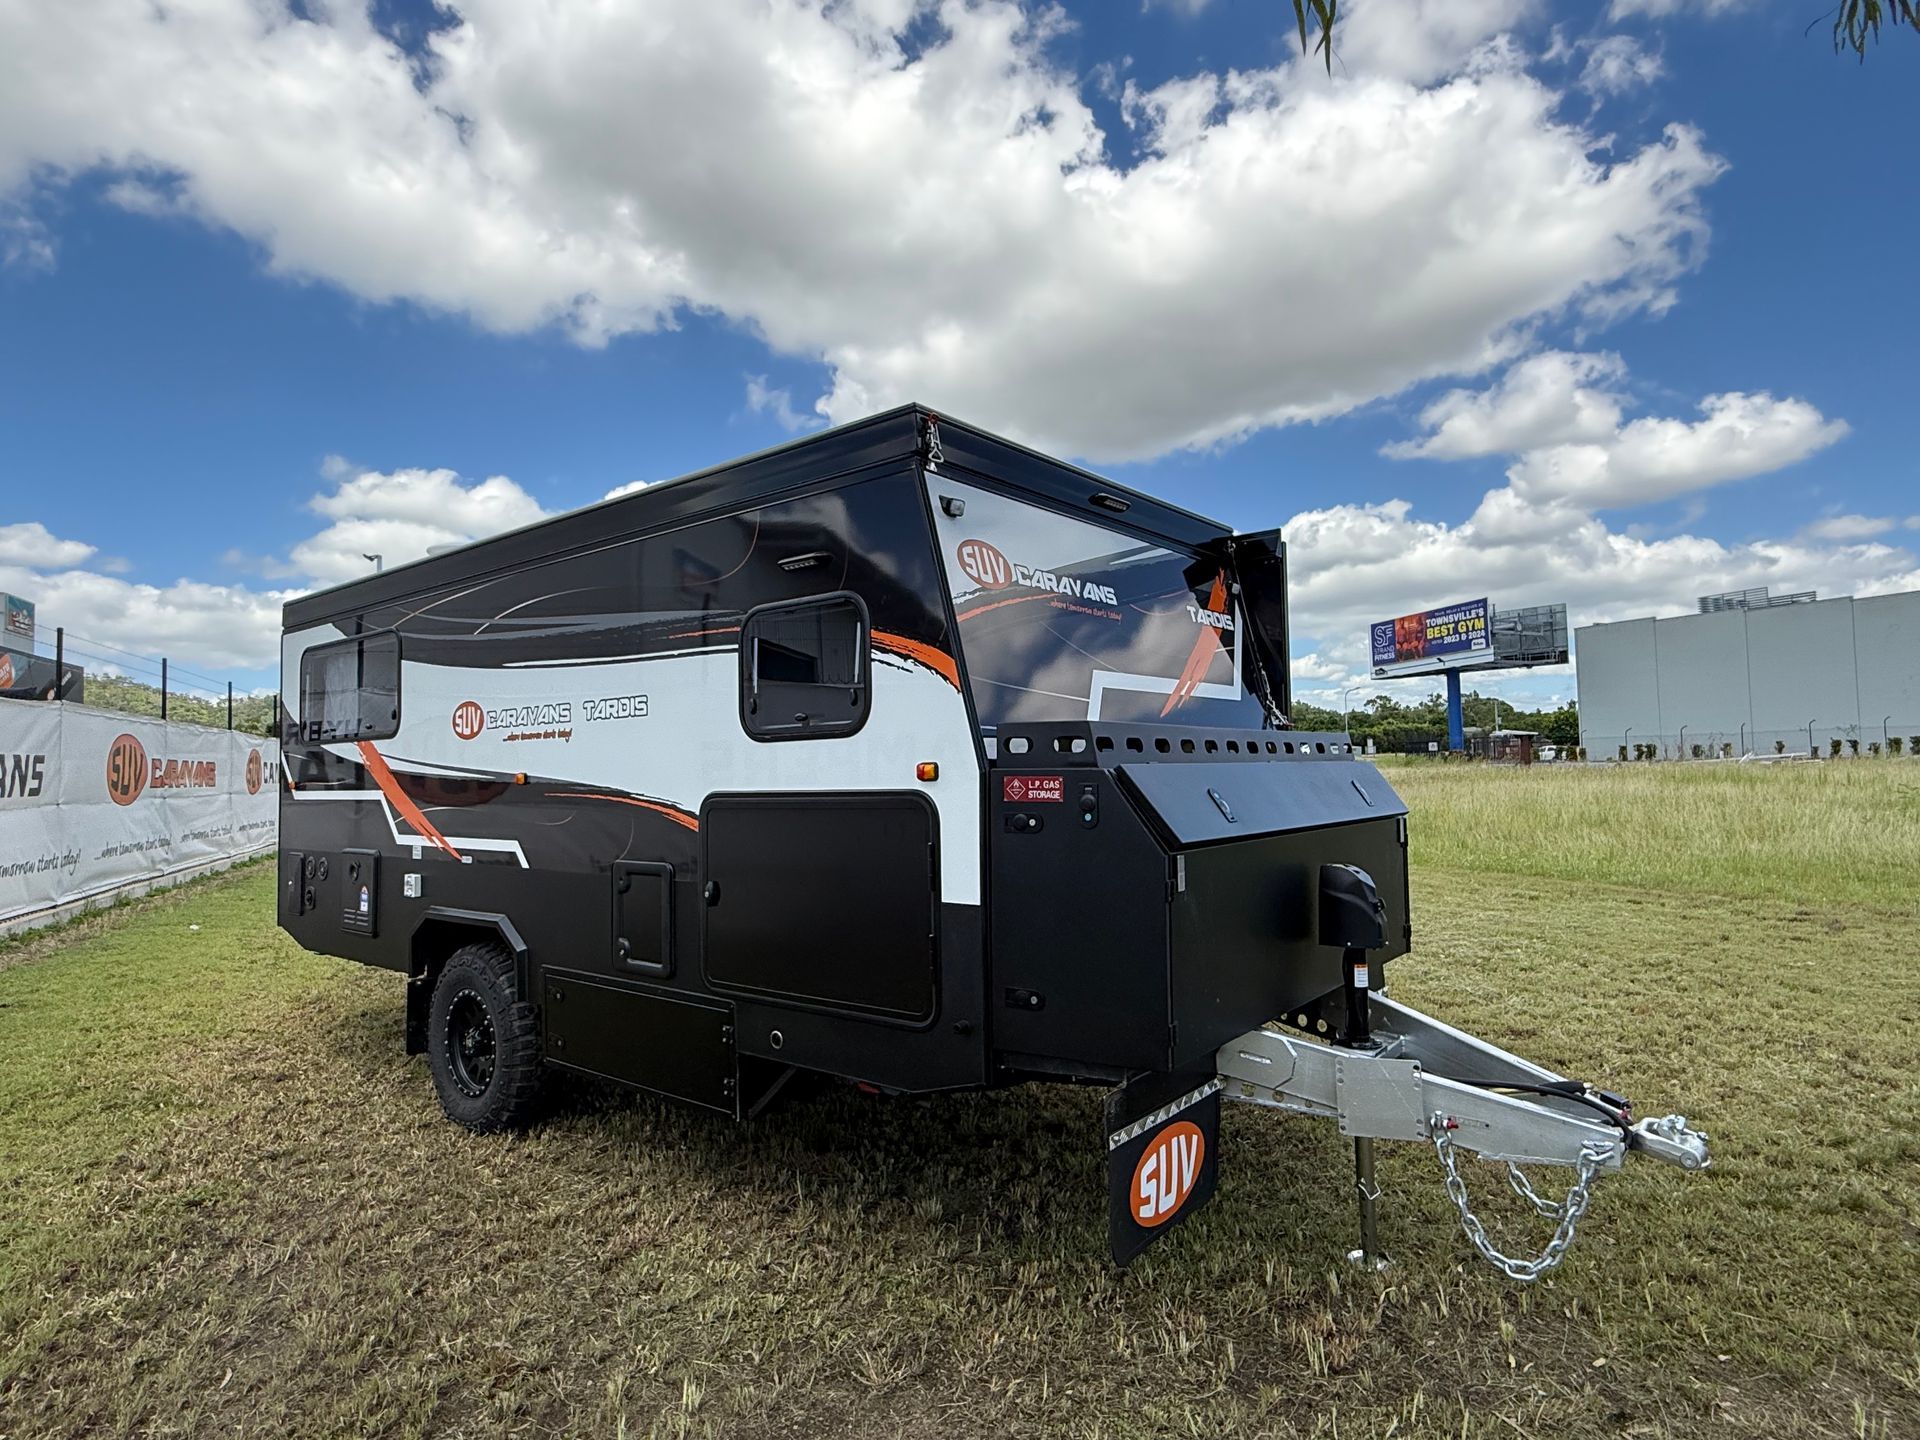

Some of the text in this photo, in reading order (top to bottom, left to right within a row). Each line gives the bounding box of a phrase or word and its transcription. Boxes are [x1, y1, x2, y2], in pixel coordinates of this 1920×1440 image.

[961, 545, 1118, 606] SUV CARAVANS
[1186, 604, 1234, 631] TARDIS
[1425, 607, 1485, 628] TOWNSVILLE'S
[1426, 617, 1485, 640] BEST GYM
[1374, 624, 1394, 647] SF
[1443, 634, 1460, 644] 2023
[1468, 630, 1486, 639] 2024
[1374, 652, 1395, 662] FITNESS
[455, 694, 649, 735] SUV CARAVANS TARDIS
[111, 743, 216, 796] SUV CARAVANS
[1028, 790, 1061, 799] STORAGE
[1043, 780, 1060, 789] GAS
[36, 852, 60, 874] starts
[1139, 1134, 1198, 1218] SUV
